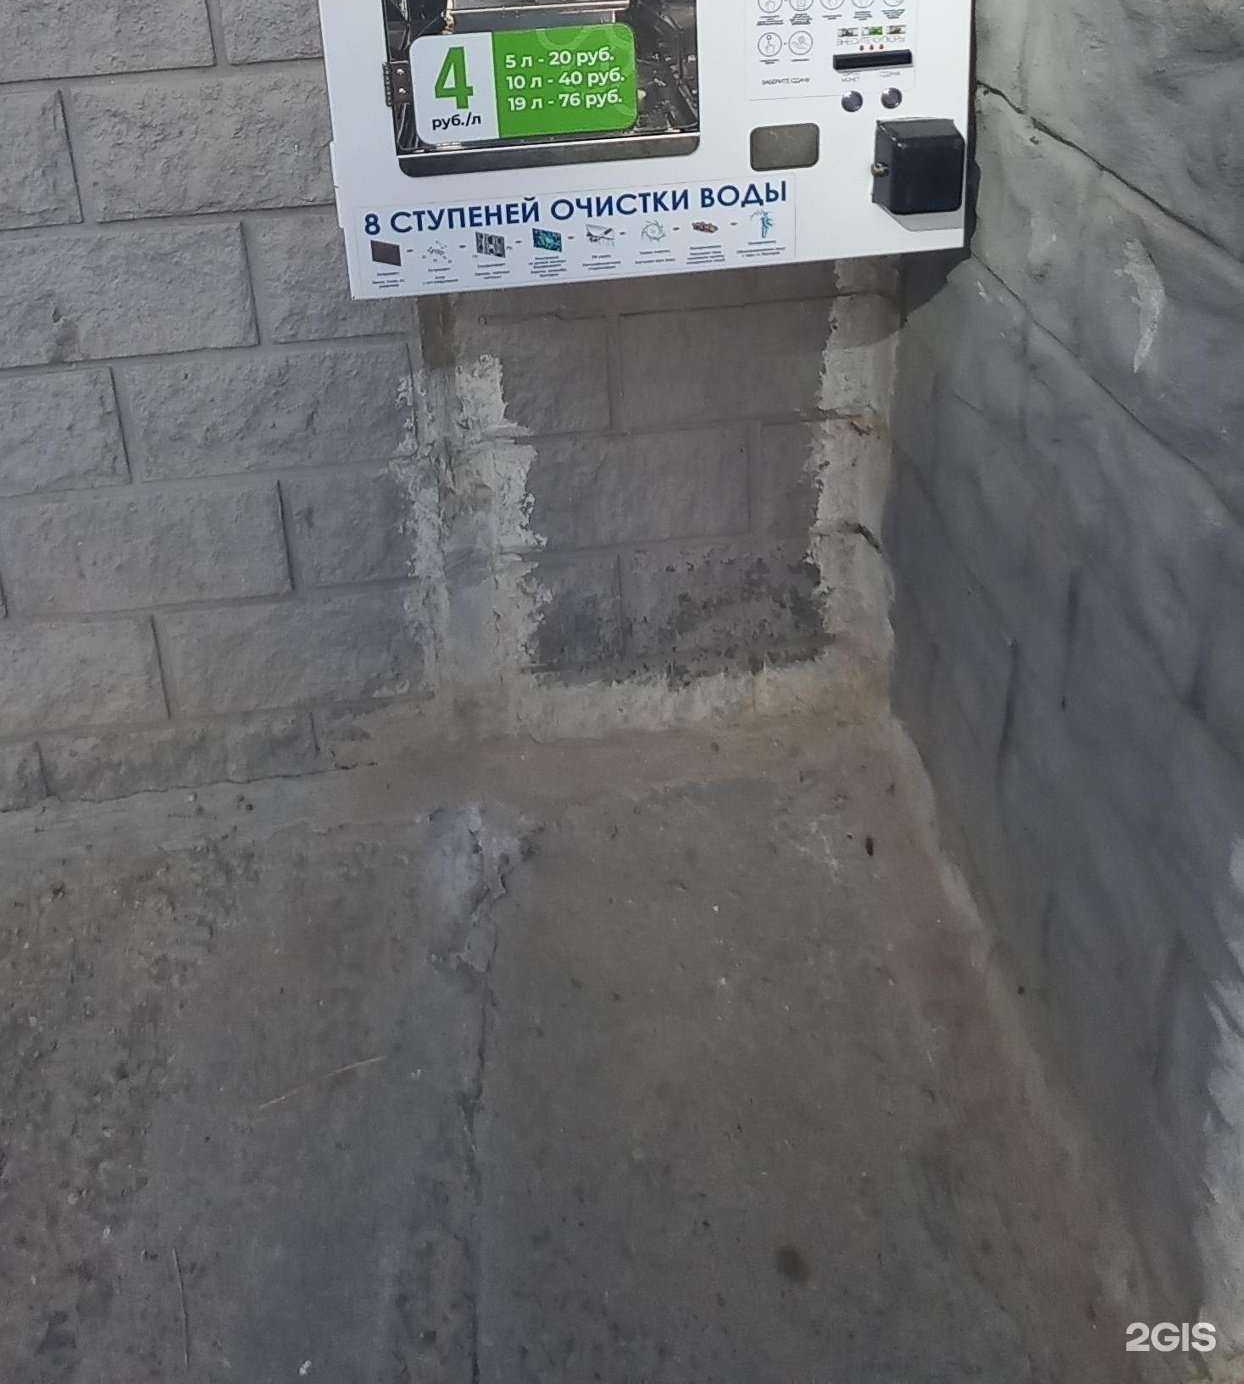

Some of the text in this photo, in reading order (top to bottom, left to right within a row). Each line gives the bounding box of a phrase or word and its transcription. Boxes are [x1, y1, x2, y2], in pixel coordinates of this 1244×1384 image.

[505, 54, 517, 69] 5
[520, 56, 533, 68] л
[549, 50, 572, 65] 20
[576, 47, 614, 66] руб.
[434, 45, 474, 110] 4
[506, 75, 526, 90] 10
[529, 76, 543, 89] л
[558, 70, 583, 86] 40
[587, 66, 625, 85] руб.
[507, 96, 527, 112] 19
[529, 98, 543, 111] л
[558, 92, 581, 107] 76
[585, 88, 623, 108] руб.
[431, 112, 482, 131] руб./л
[364, 180, 787, 236] 8 СТУПЕНЕЙ ОЧИСТКИ ВОДЫ
